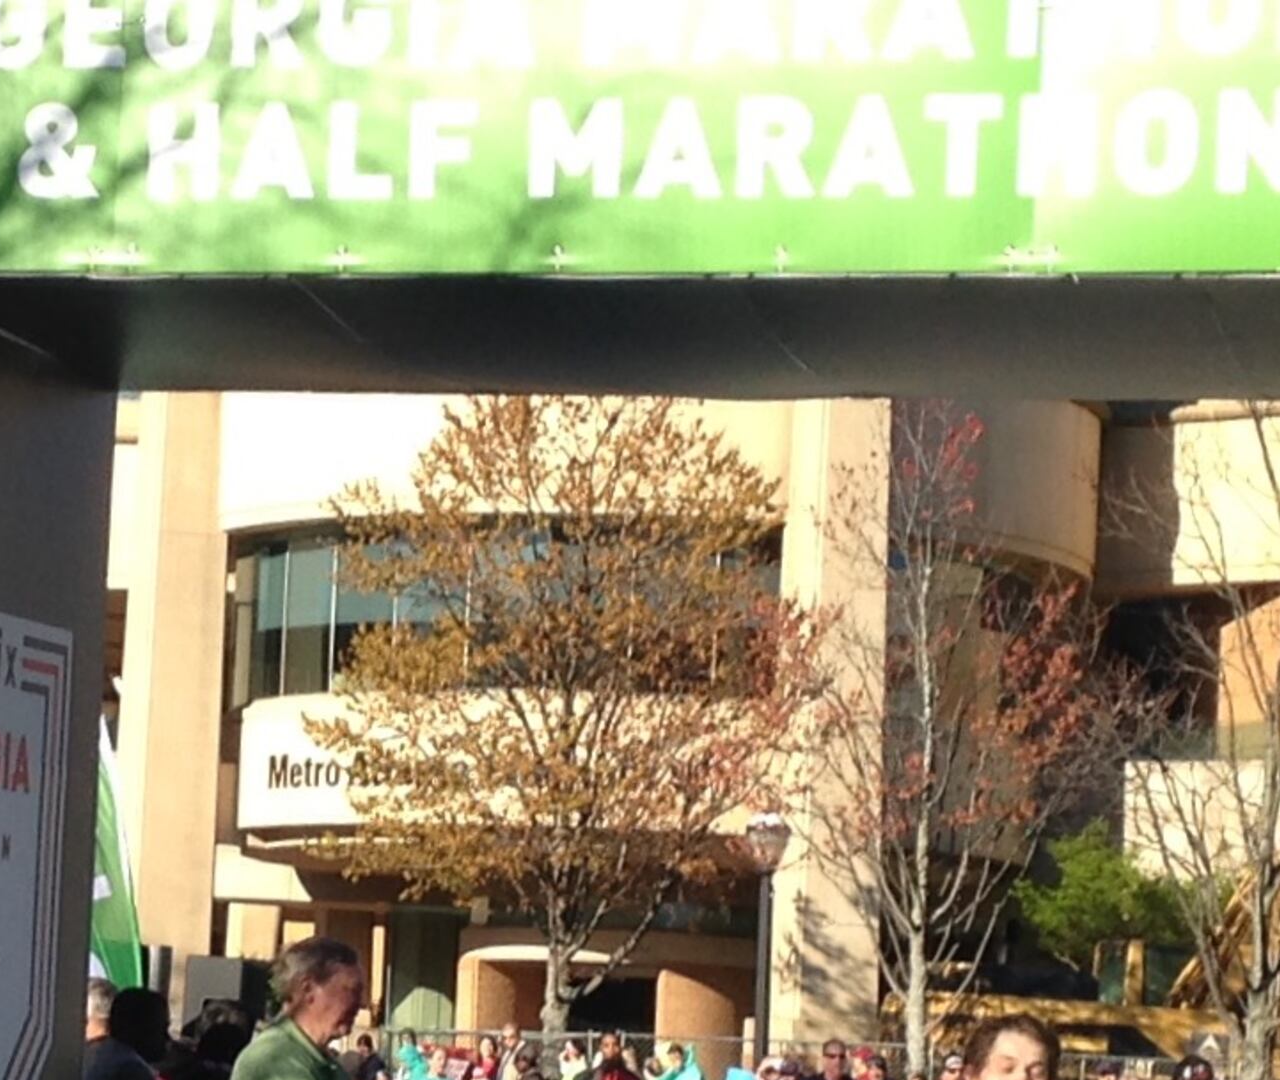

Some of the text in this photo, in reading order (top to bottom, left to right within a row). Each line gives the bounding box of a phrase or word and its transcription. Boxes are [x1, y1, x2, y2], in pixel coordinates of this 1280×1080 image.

[20, 101, 100, 199] &
[146, 99, 480, 200] HALF
[269, 754, 341, 789] Metro
